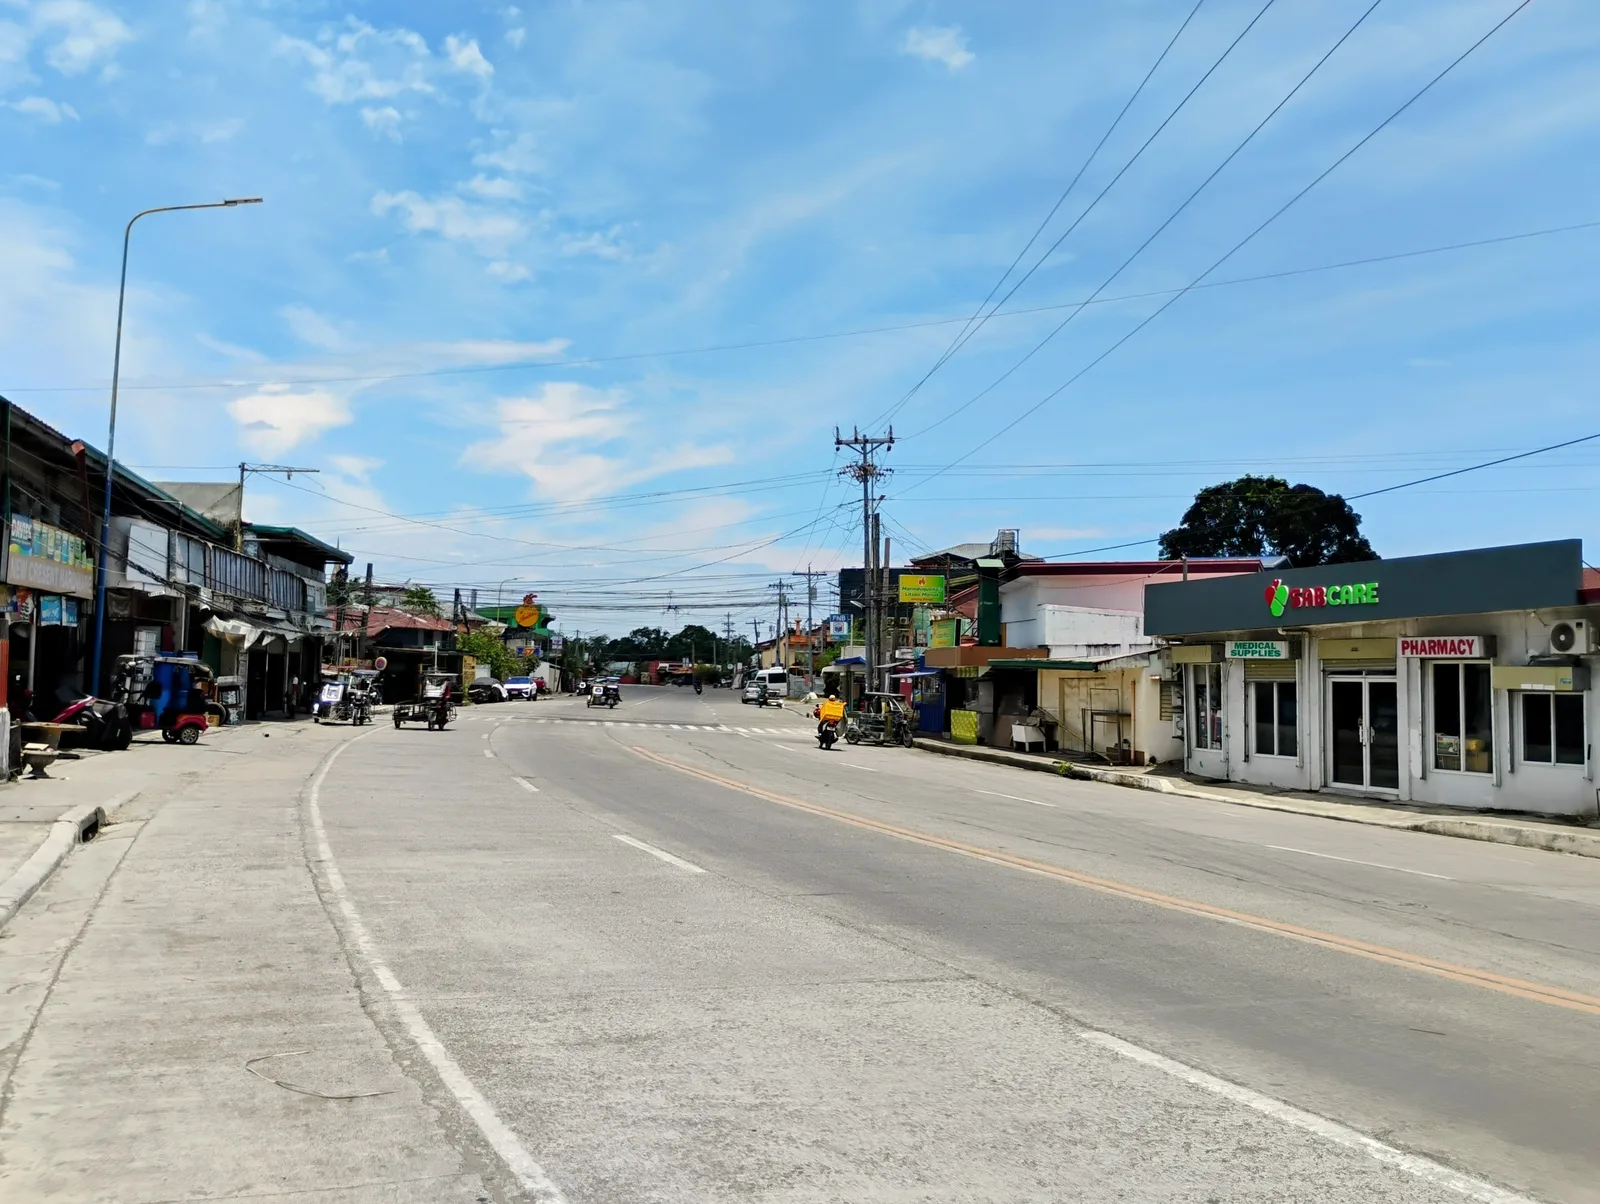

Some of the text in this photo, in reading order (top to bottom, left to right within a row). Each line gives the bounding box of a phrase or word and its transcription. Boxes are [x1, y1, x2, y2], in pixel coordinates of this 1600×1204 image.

[1290, 582, 1379, 609] SABCARE
[1234, 642, 1277, 650] MEDICAL
[1401, 639, 1475, 656] PHARMACY
[1230, 649, 1282, 657] SUPPLIES
